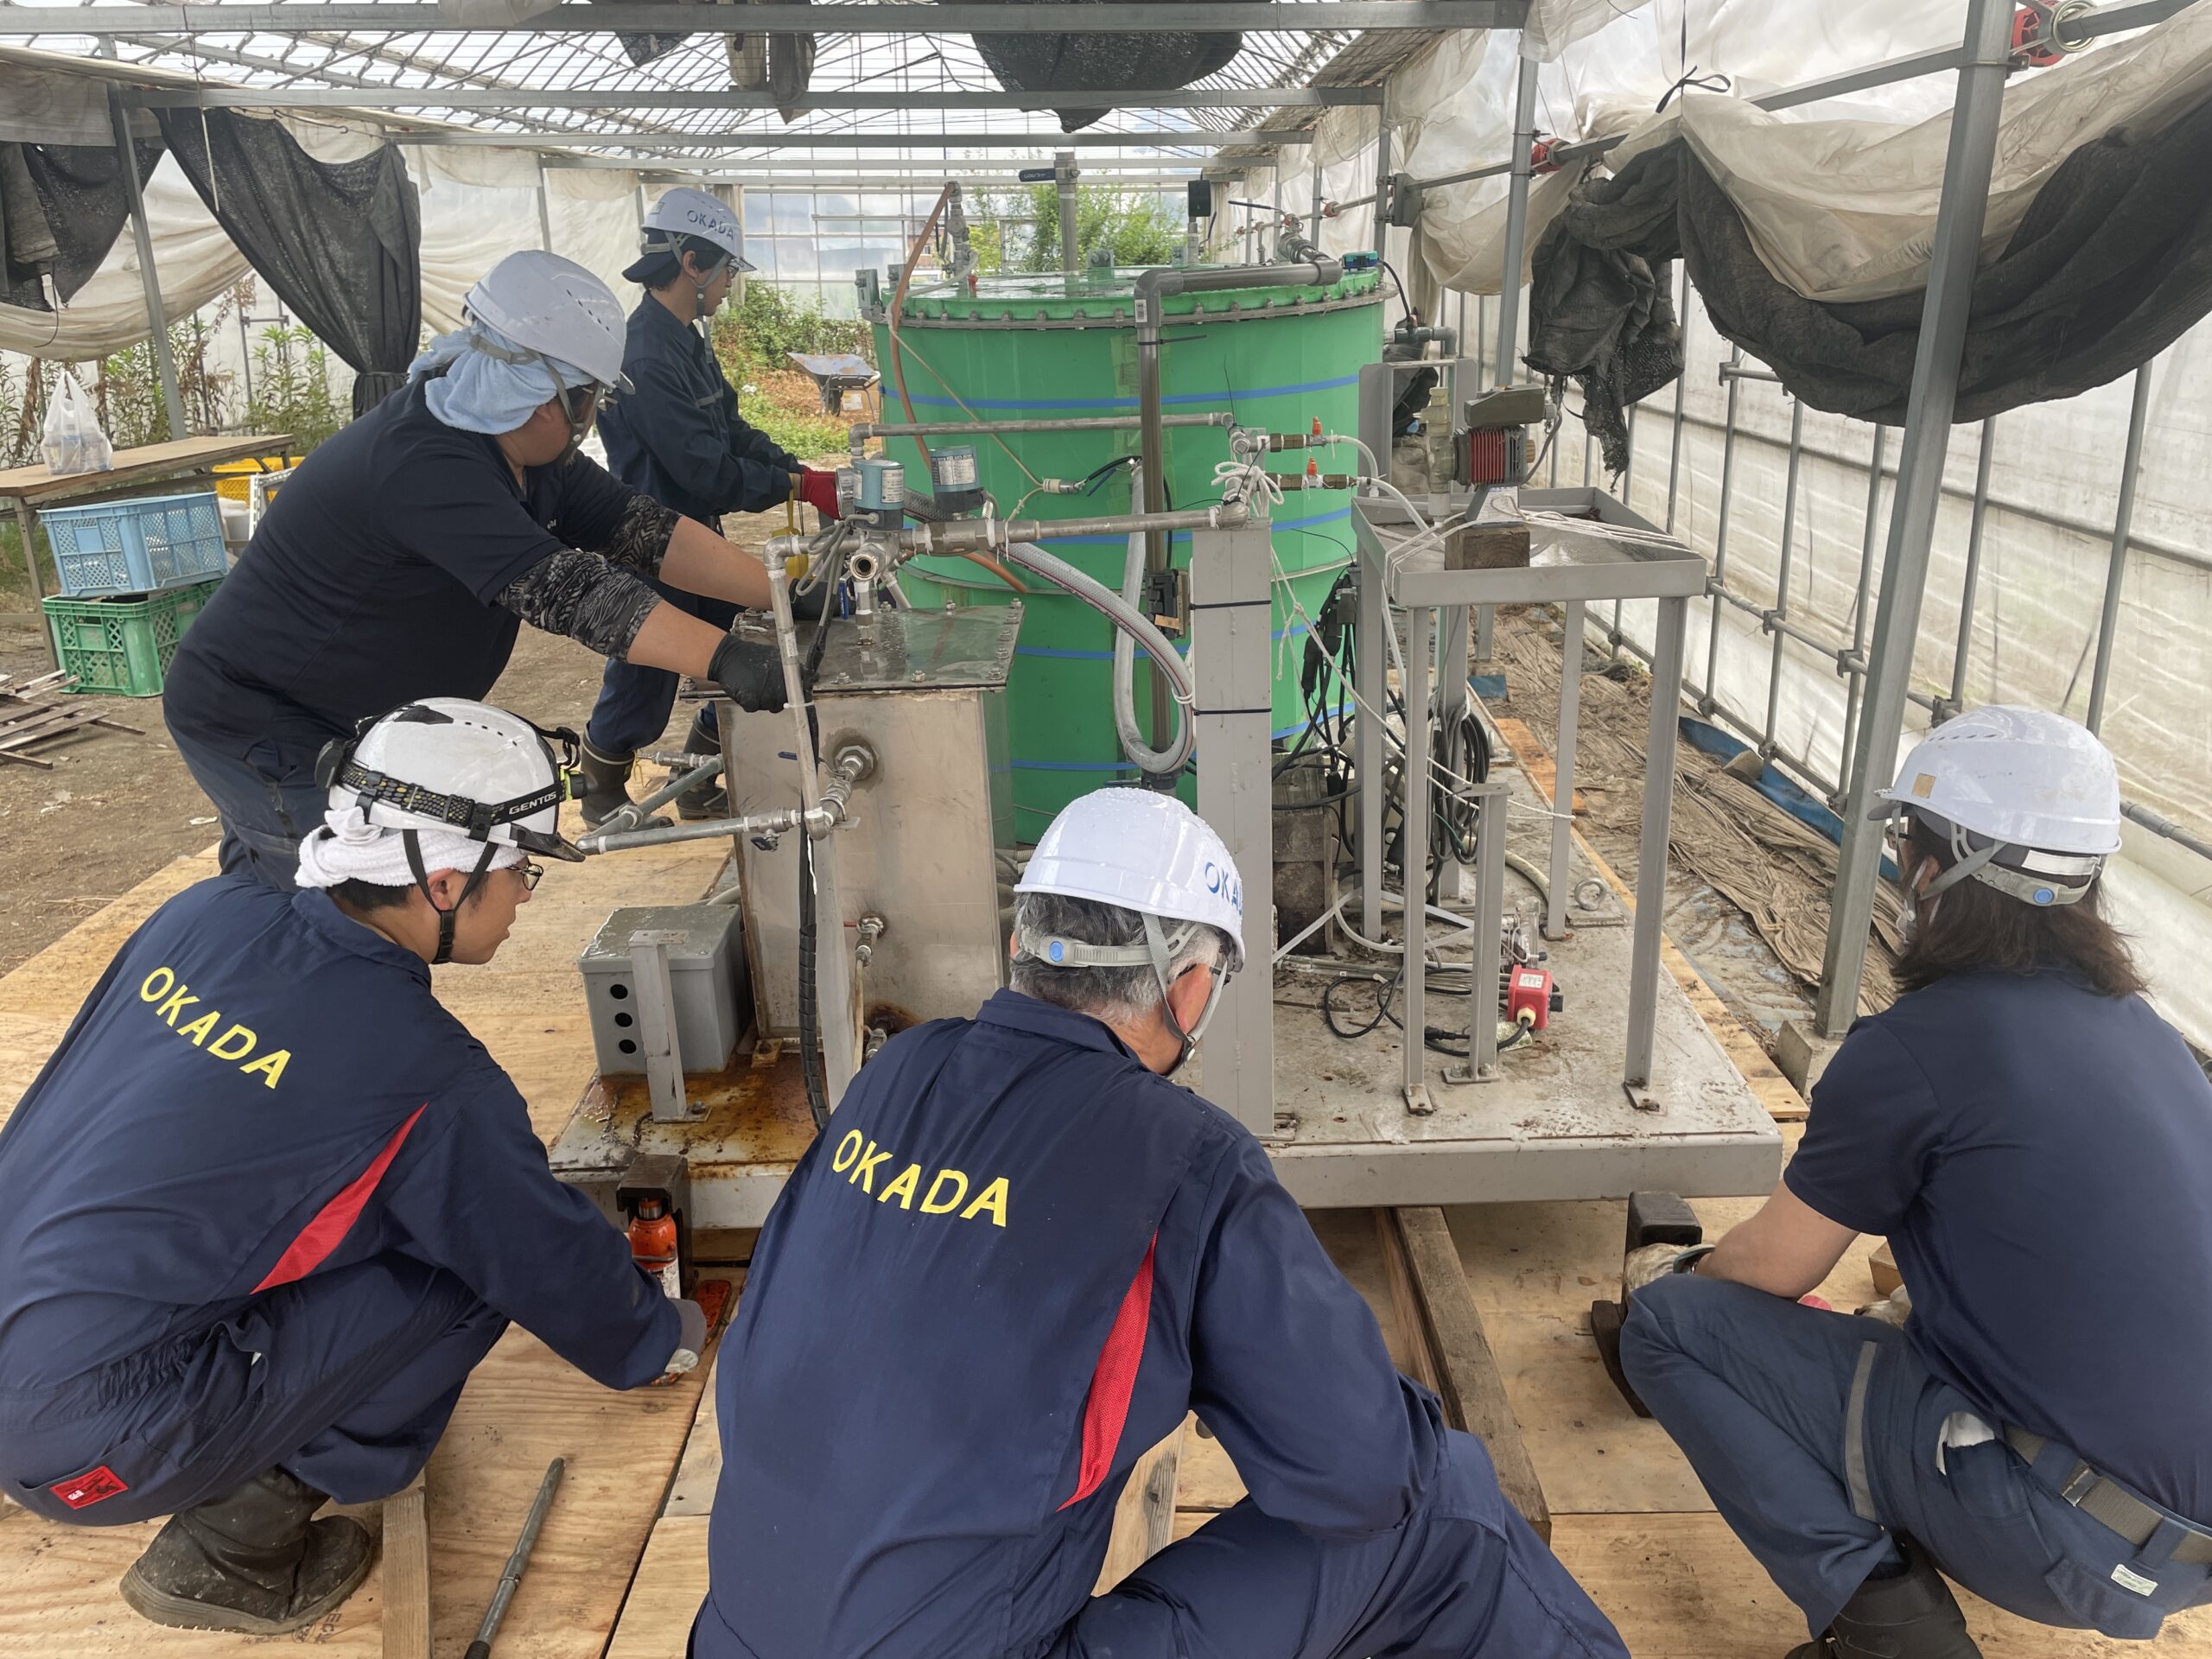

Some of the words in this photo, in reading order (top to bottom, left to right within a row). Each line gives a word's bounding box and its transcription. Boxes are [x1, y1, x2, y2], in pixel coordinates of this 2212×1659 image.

[687, 210, 734, 240] OKADA
[508, 791, 557, 815] GENTOS
[140, 966, 291, 1090] OKADA
[832, 1128, 1009, 1228] OKADA
